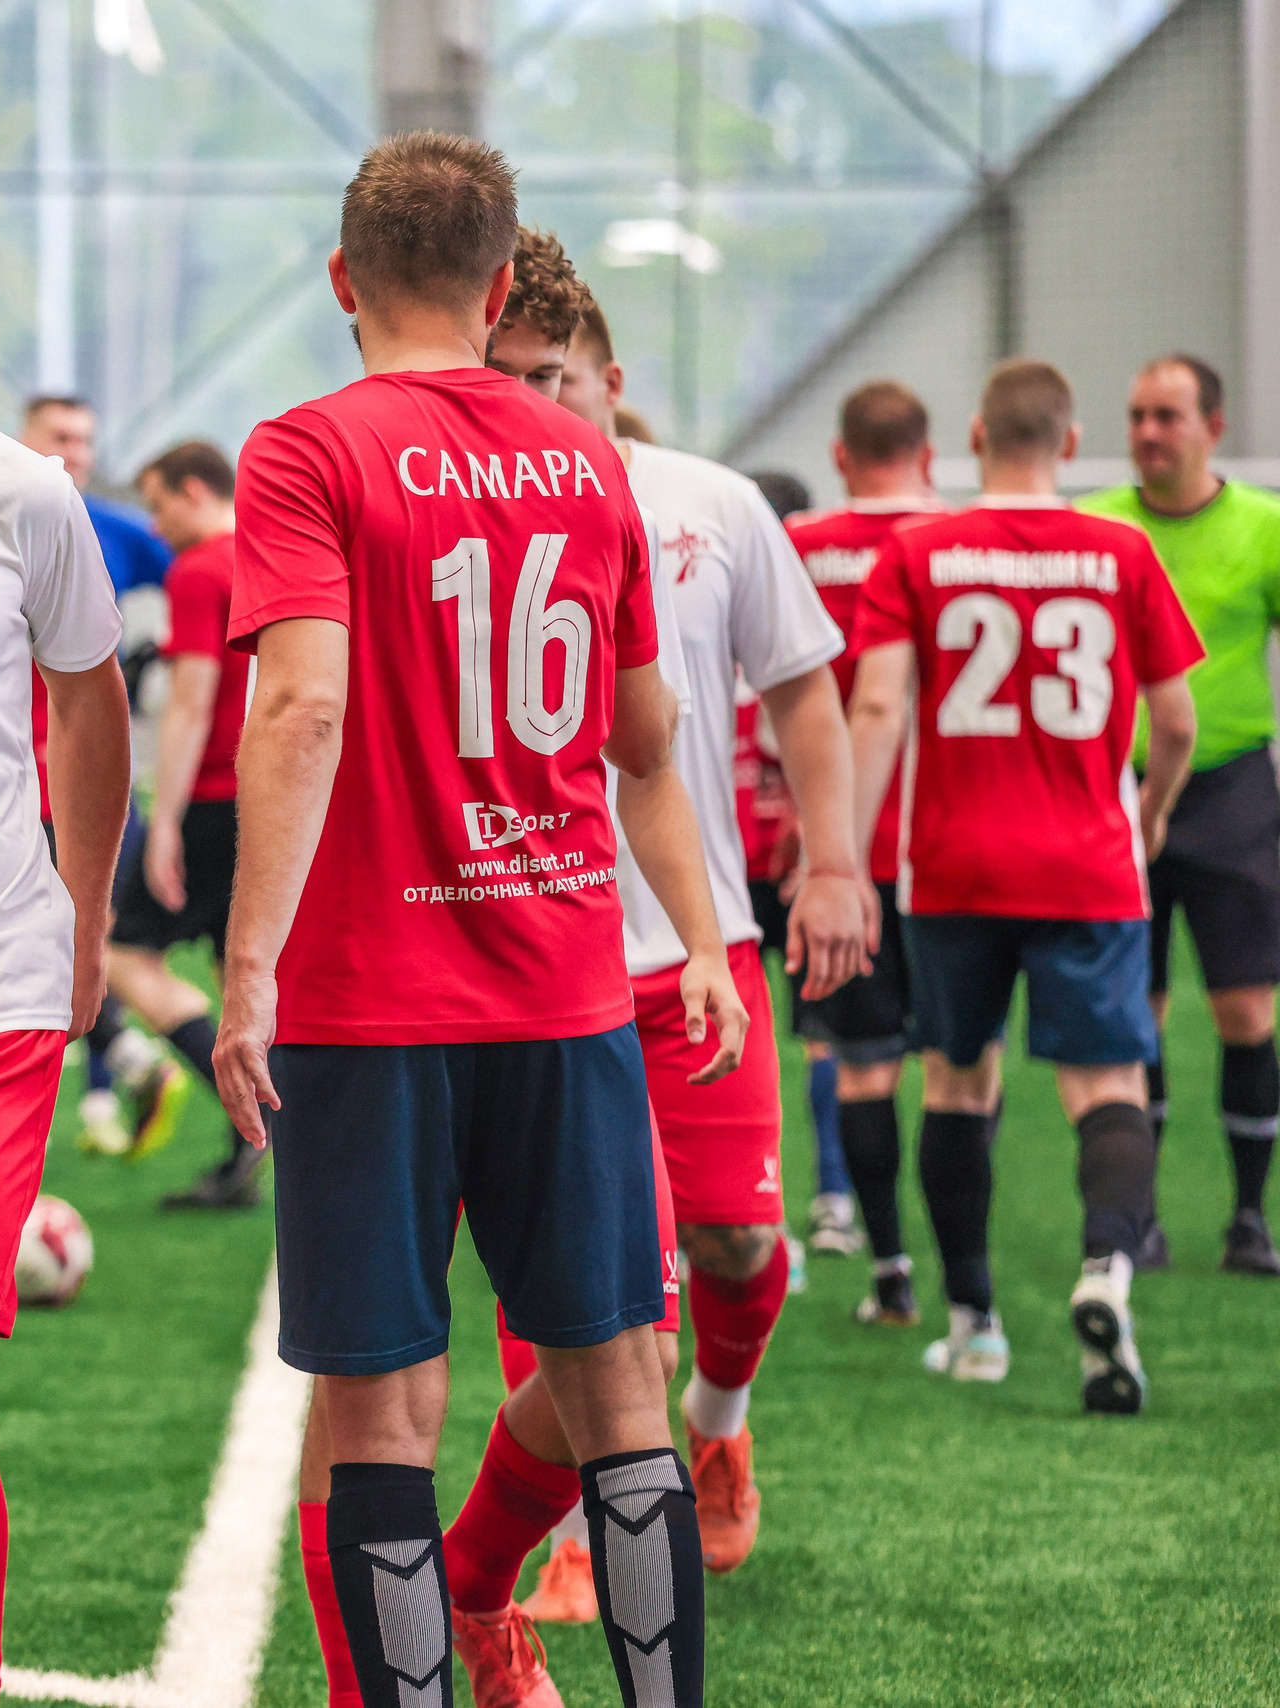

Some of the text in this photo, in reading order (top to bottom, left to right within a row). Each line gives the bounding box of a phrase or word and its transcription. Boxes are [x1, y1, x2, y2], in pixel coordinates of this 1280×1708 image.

[398, 446, 607, 499] САМАРА
[432, 533, 592, 758] 16
[935, 591, 1116, 741] 23
[403, 866, 616, 904] ОТДЕЛОЧНЫЕ МАТЕРИАЛ
[458, 850, 584, 879] www.disort.ru
